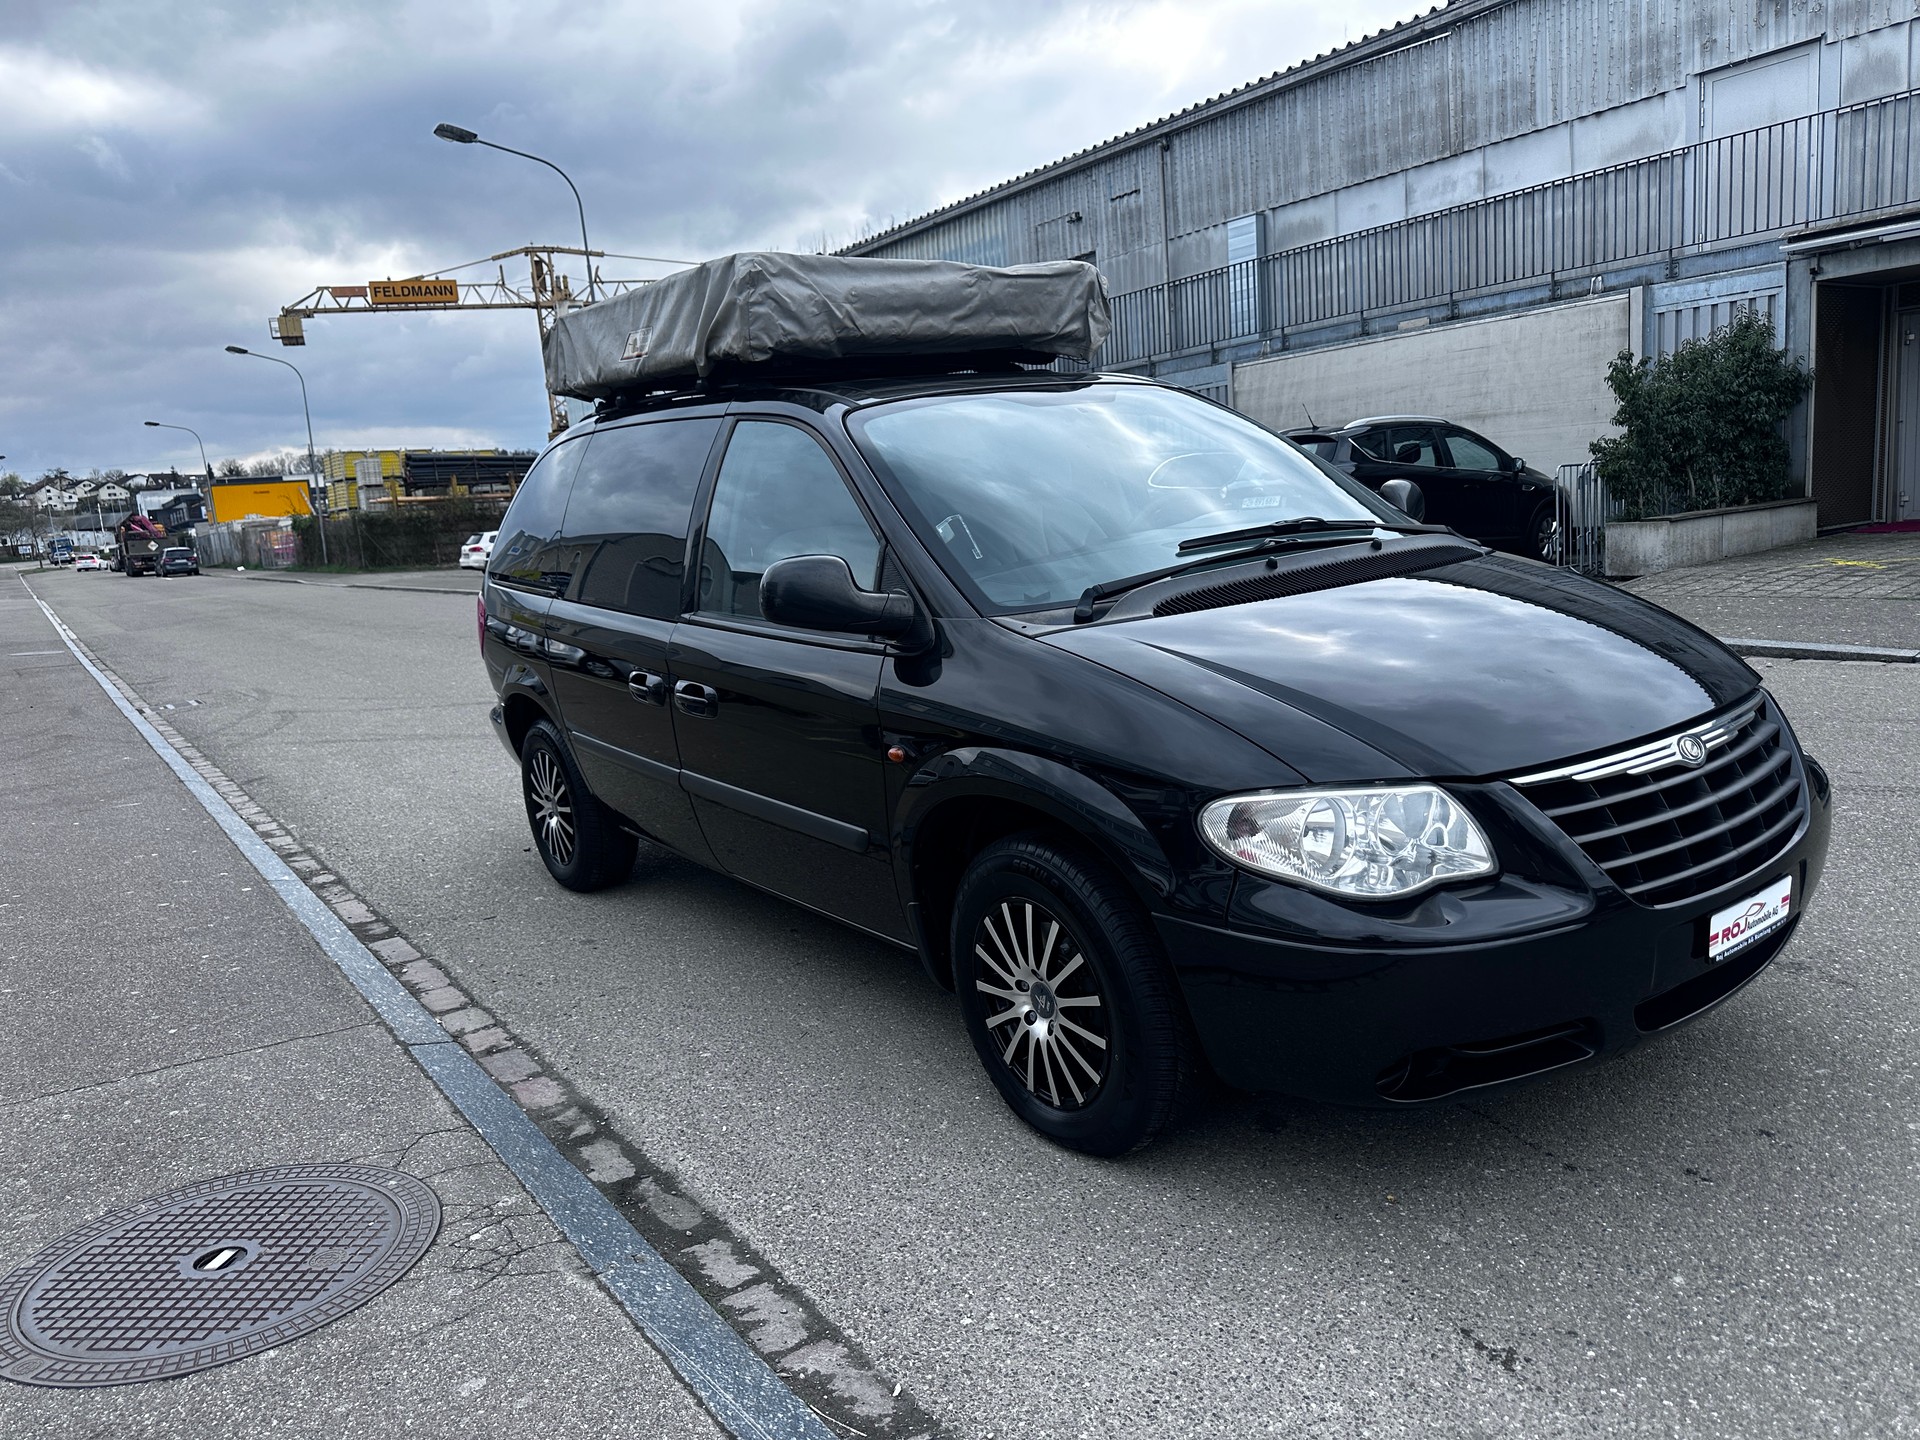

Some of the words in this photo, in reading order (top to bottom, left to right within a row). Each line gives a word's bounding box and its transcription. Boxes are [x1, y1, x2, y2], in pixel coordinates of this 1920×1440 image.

[373, 285, 454, 298] FELDMANN
[1721, 917, 1748, 944] ROJ
[1747, 910, 1771, 931] Automobile
[1772, 905, 1779, 917] AG
